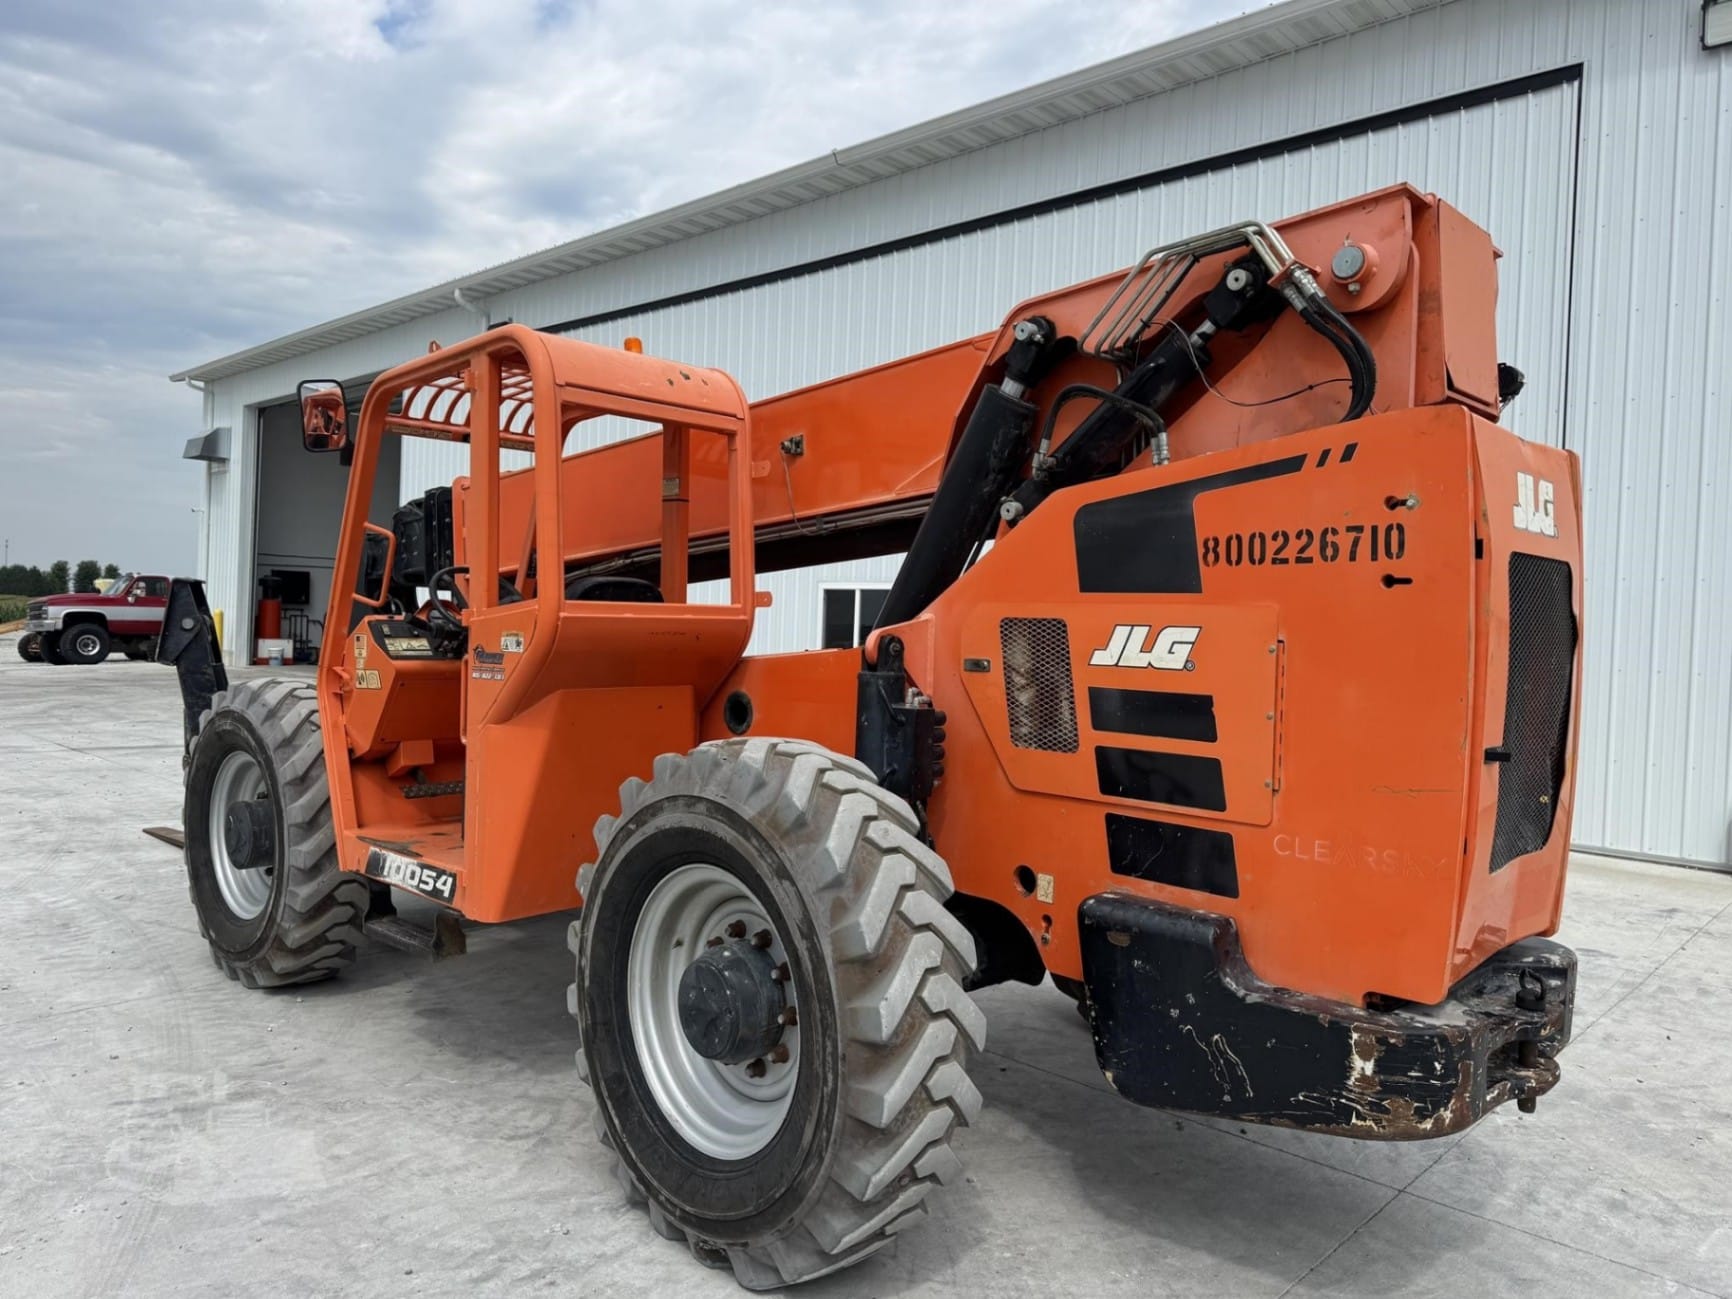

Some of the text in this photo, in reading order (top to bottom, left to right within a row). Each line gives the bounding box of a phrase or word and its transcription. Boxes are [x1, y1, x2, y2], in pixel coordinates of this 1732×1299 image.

[1512, 470, 1559, 539] JLG
[1202, 522, 1406, 568] 800226710
[382, 854, 454, 898] 10054
